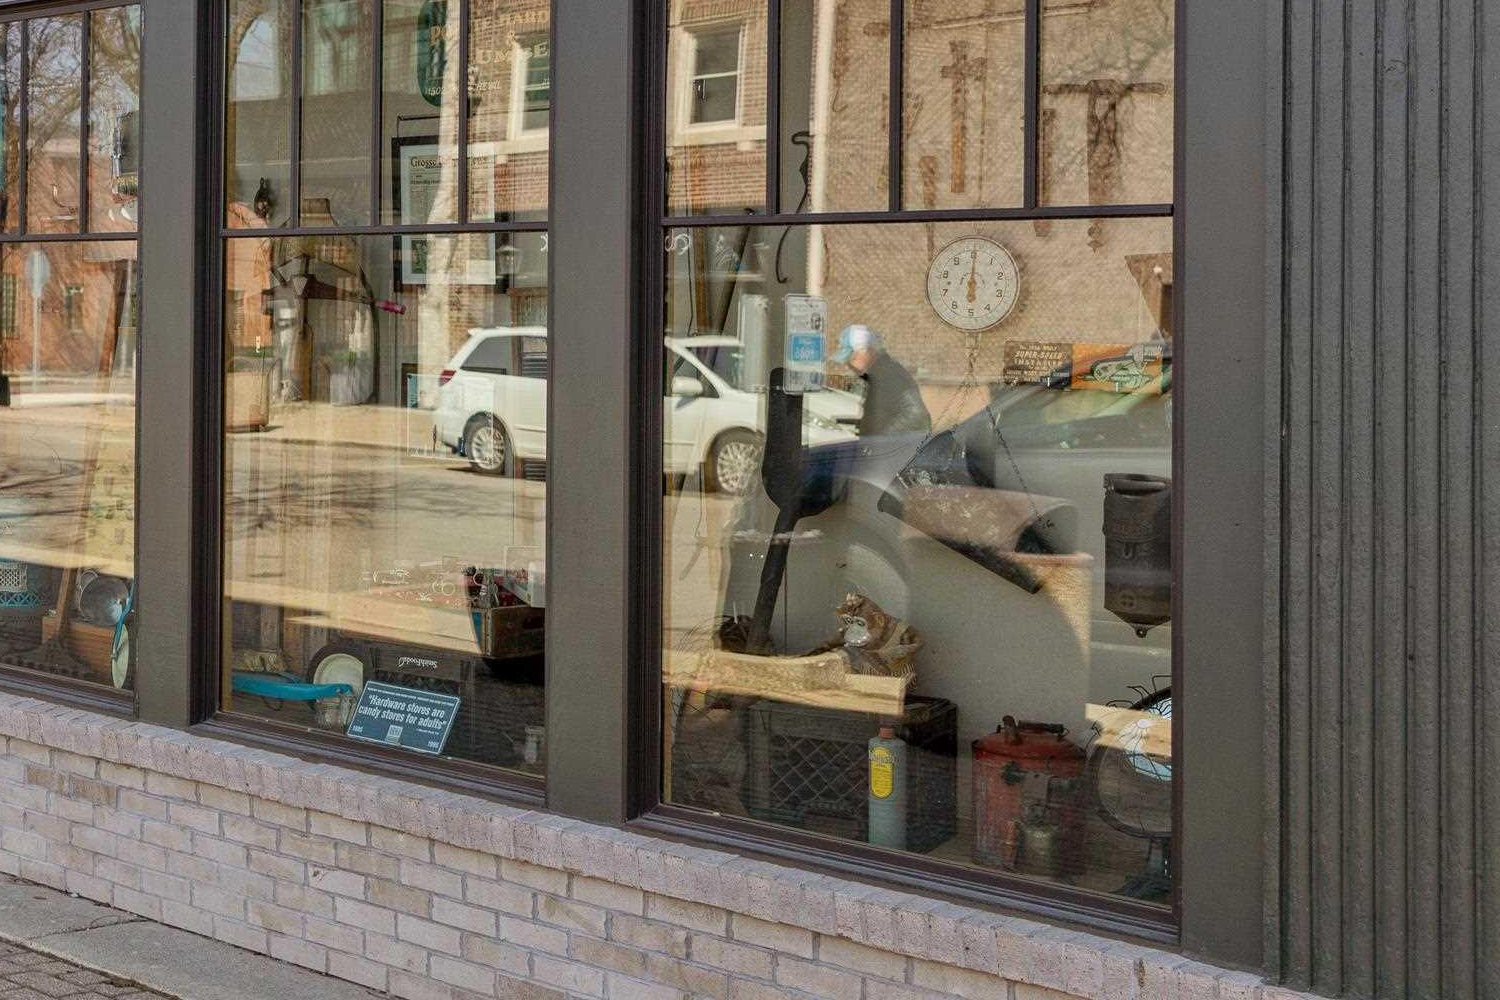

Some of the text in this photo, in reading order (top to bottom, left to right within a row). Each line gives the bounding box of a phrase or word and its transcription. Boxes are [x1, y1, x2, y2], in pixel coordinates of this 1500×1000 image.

[358, 705, 381, 719] candy
[381, 709, 405, 722] stores
[405, 713, 418, 724] for
[407, 702, 431, 716] stores
